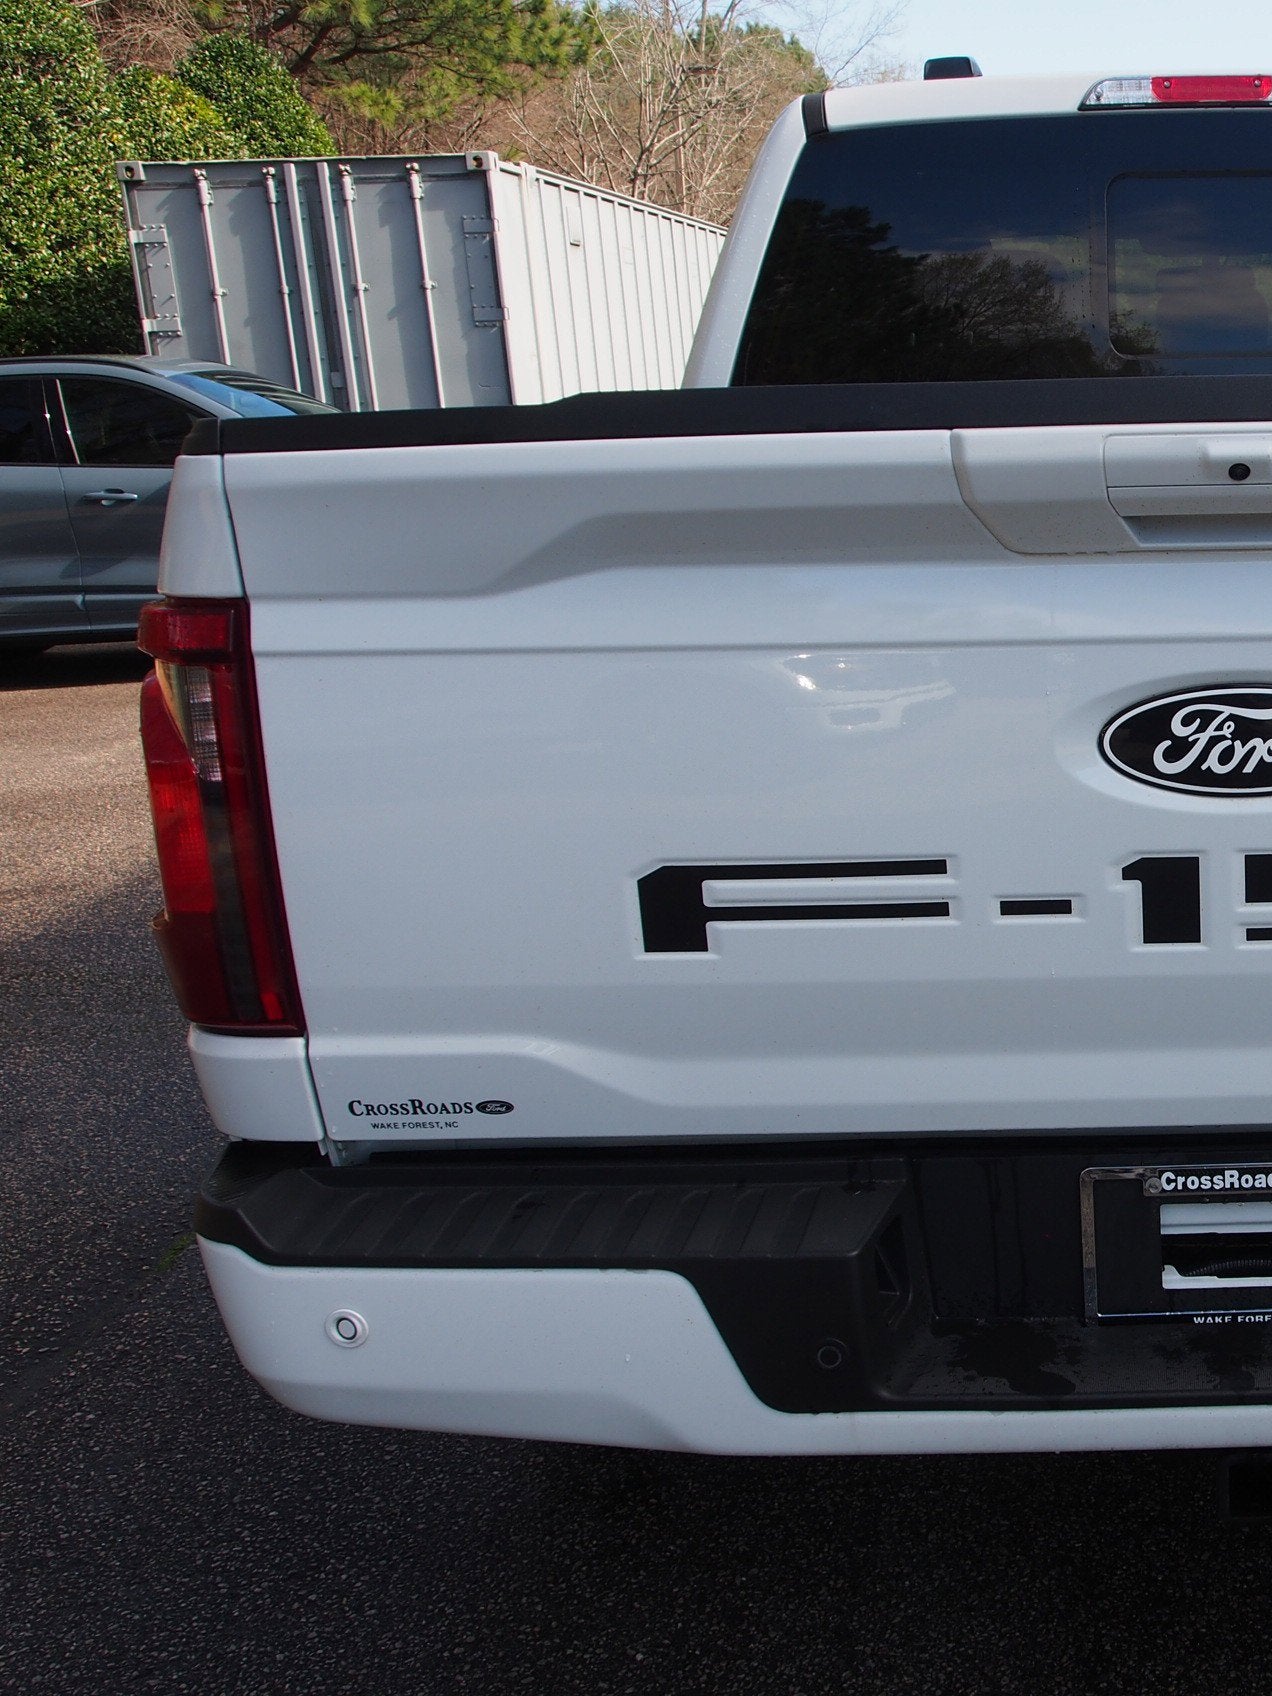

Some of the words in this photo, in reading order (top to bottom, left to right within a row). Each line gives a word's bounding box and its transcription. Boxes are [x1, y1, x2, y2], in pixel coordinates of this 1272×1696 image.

[371, 1122, 401, 1130] WAKE
[402, 1121, 444, 1130] FOREST,
[1193, 1316, 1232, 1324] WAKE
